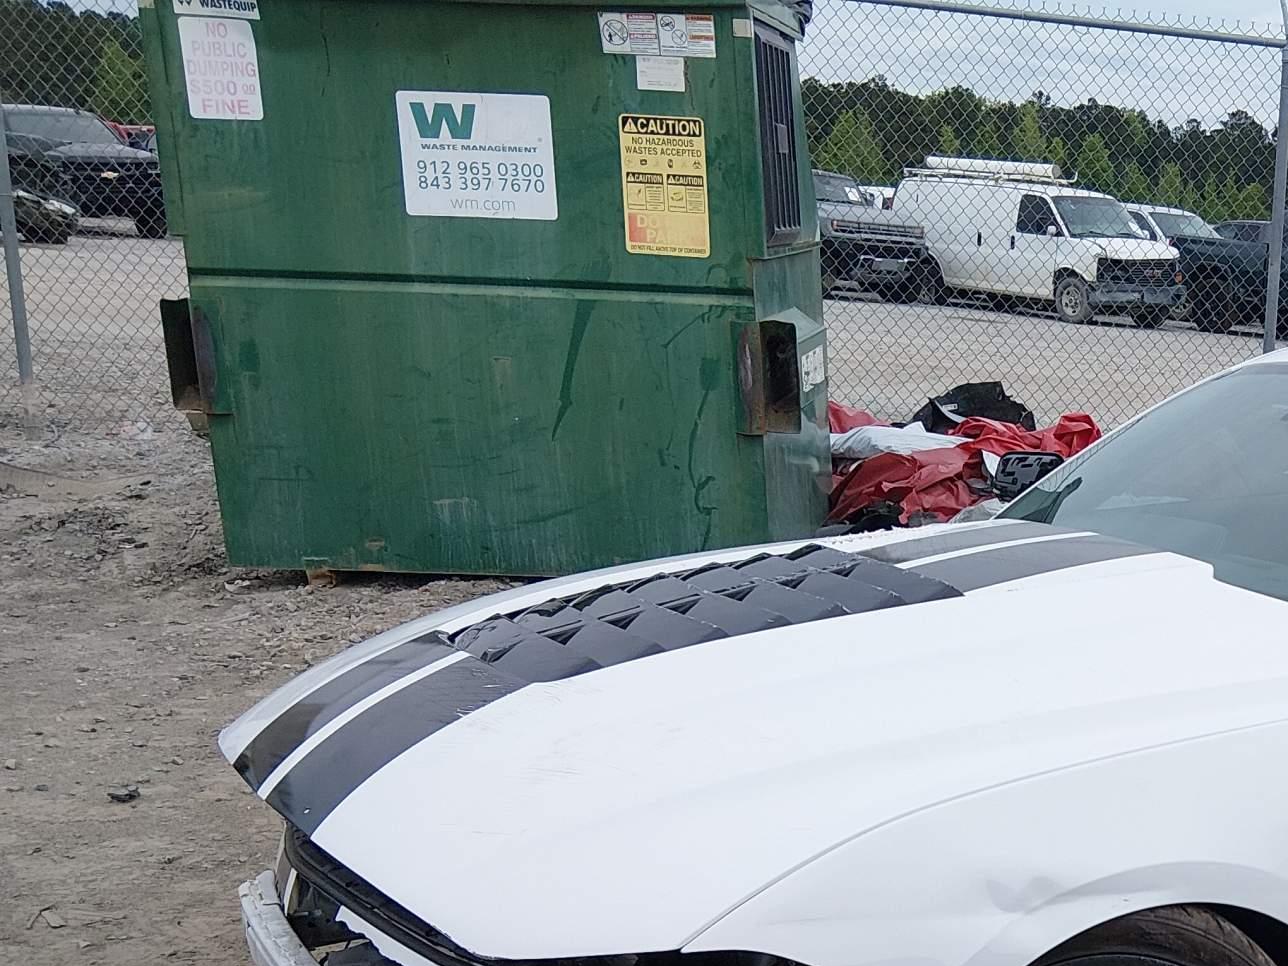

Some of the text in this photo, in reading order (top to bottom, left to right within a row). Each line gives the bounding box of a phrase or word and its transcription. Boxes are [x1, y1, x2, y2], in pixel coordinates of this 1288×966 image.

[199, 0, 257, 12] WASTEQUIP
[206, 22, 228, 38] NO
[191, 40, 247, 58] PUBLIC
[186, 60, 257, 78] DUMPING
[201, 98, 250, 115] FINE
[637, 118, 700, 136] CAUTION
[420, 143, 537, 153] WASTE MANAGEMENT
[631, 136, 695, 148] NO HAZARDOUS
[625, 145, 702, 158] WASTES ACCEPTED
[416, 160, 544, 178] 912 965 0300
[418, 175, 545, 193] 843 397 7670
[634, 173, 663, 184] CAUTION
[674, 175, 703, 186] CAUTION
[450, 199, 516, 212] wm.com
